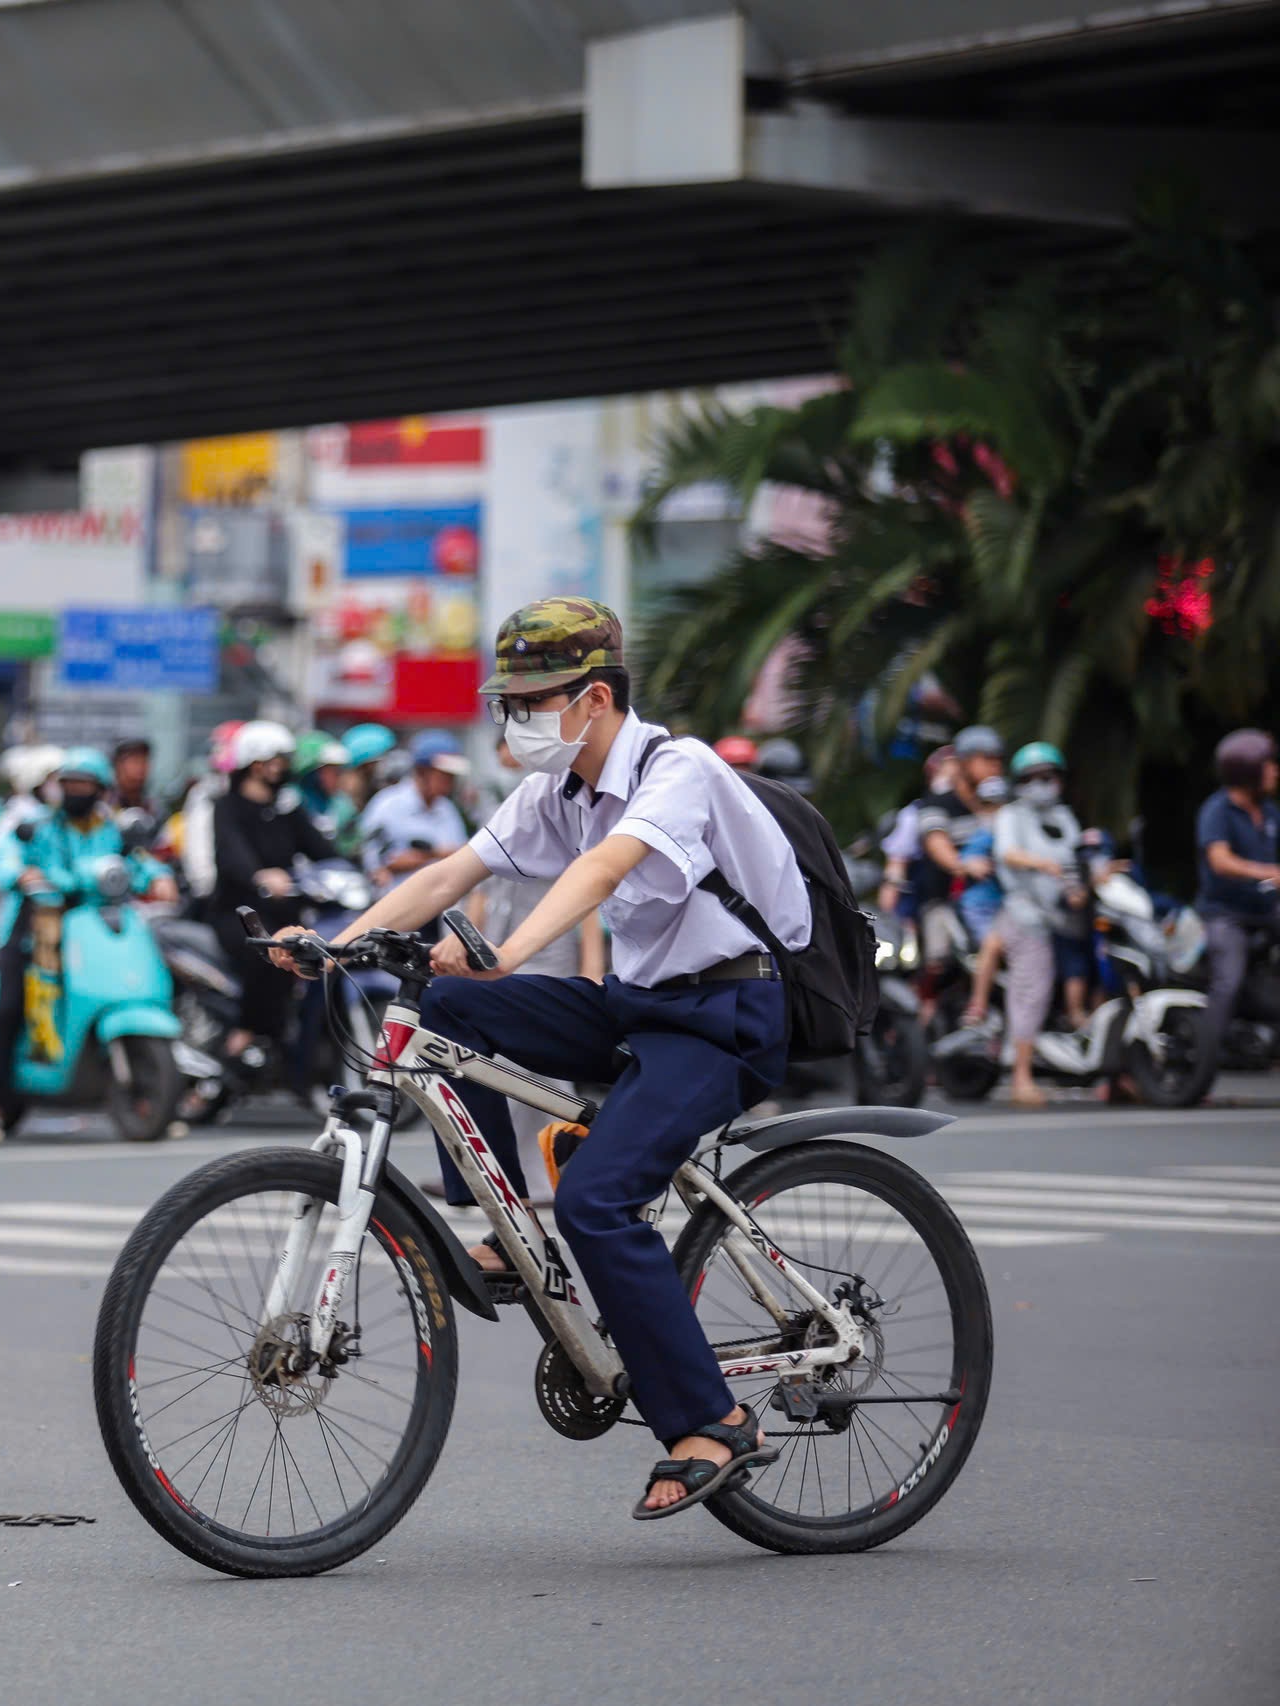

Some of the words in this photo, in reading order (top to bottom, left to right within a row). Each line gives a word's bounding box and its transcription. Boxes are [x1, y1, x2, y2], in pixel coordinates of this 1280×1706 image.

[437, 1082, 528, 1217] GLX
[401, 1234, 447, 1329] KENDA
[722, 1362, 782, 1377] GLX
[897, 1423, 949, 1501] GALAXY
